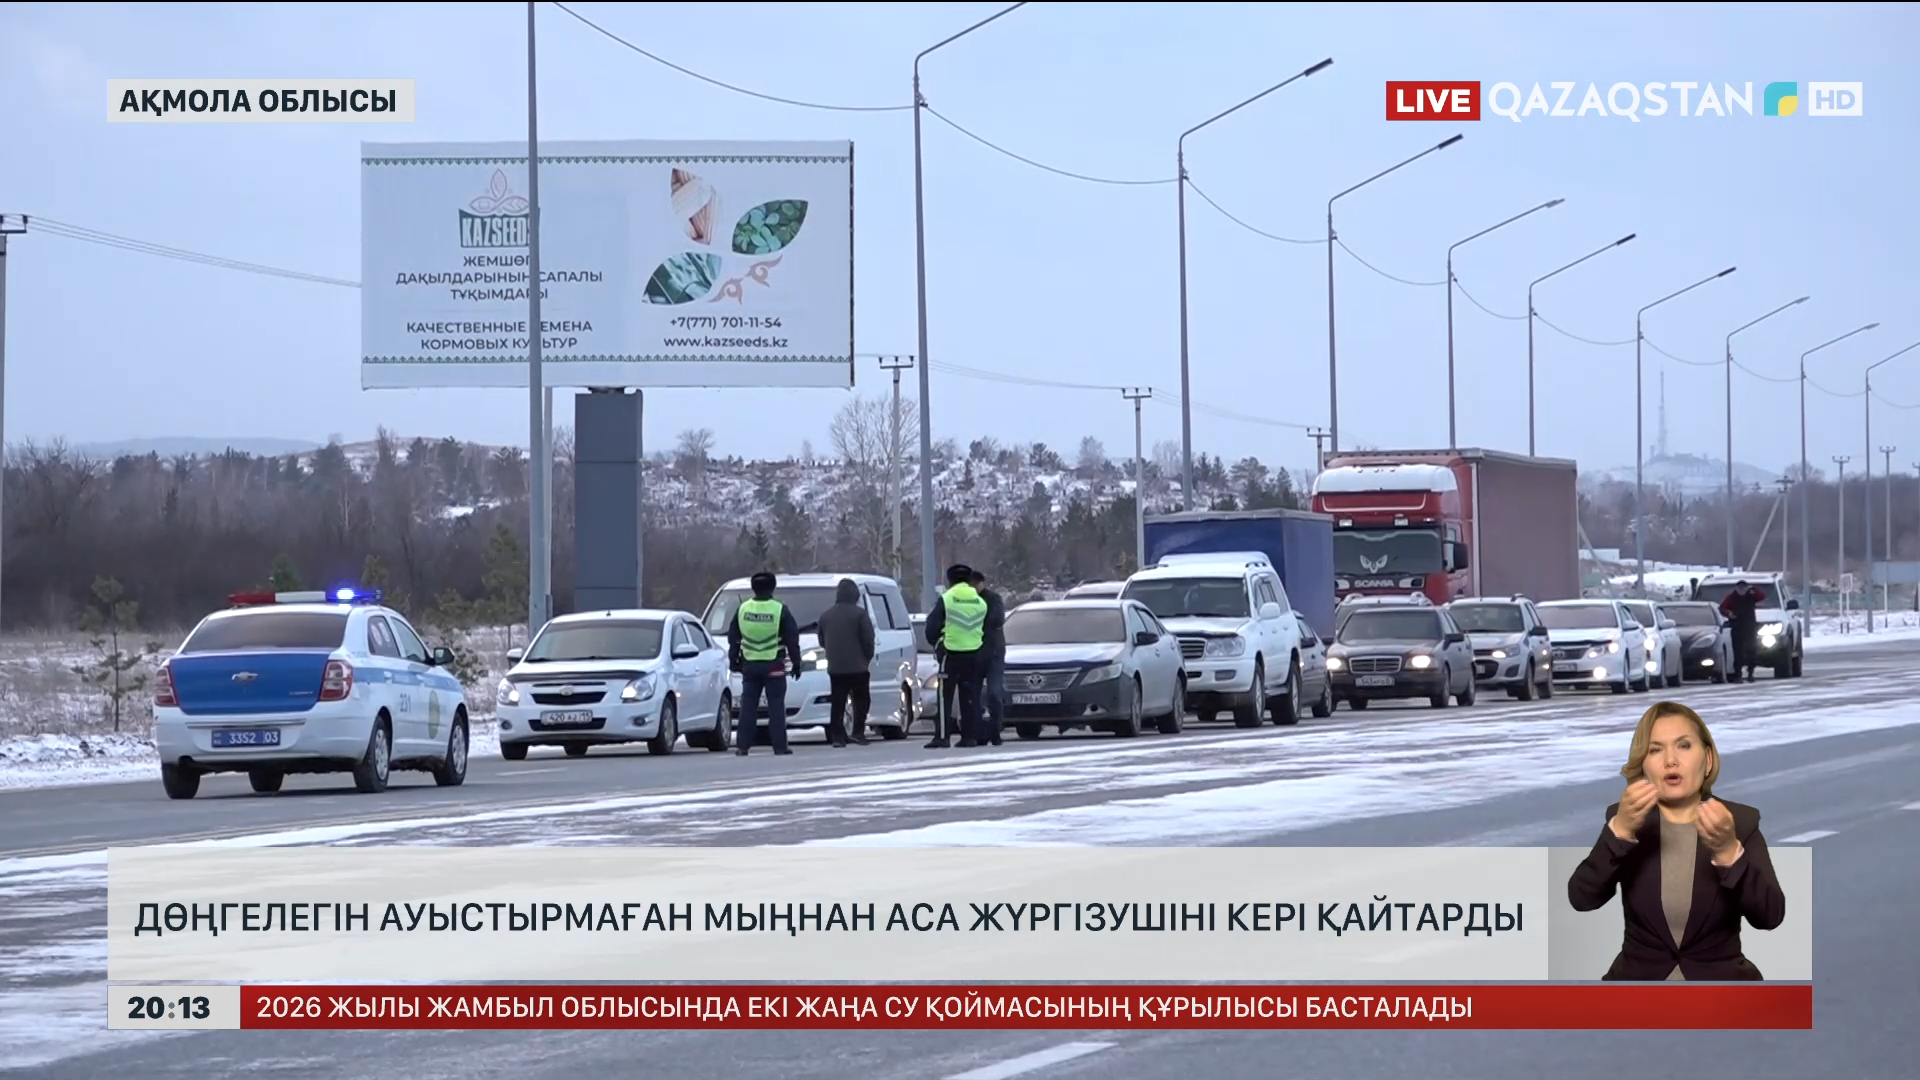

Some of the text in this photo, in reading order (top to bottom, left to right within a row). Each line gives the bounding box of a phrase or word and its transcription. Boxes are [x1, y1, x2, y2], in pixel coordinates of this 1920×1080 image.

[462, 217, 530, 247] KAZSEED
[406, 320, 593, 333] КАЧЕСТВЕННЫЕ ЕМЕНА
[670, 316, 782, 330] +7(771) 701-11-54
[421, 337, 578, 350] КОРМОВЫХ КУЬТУР
[663, 335, 788, 348] www.kazseeds.kz
[1354, 579, 1395, 588] SCANIA
[228, 732, 257, 744] 3352
[264, 731, 279, 743] 03
